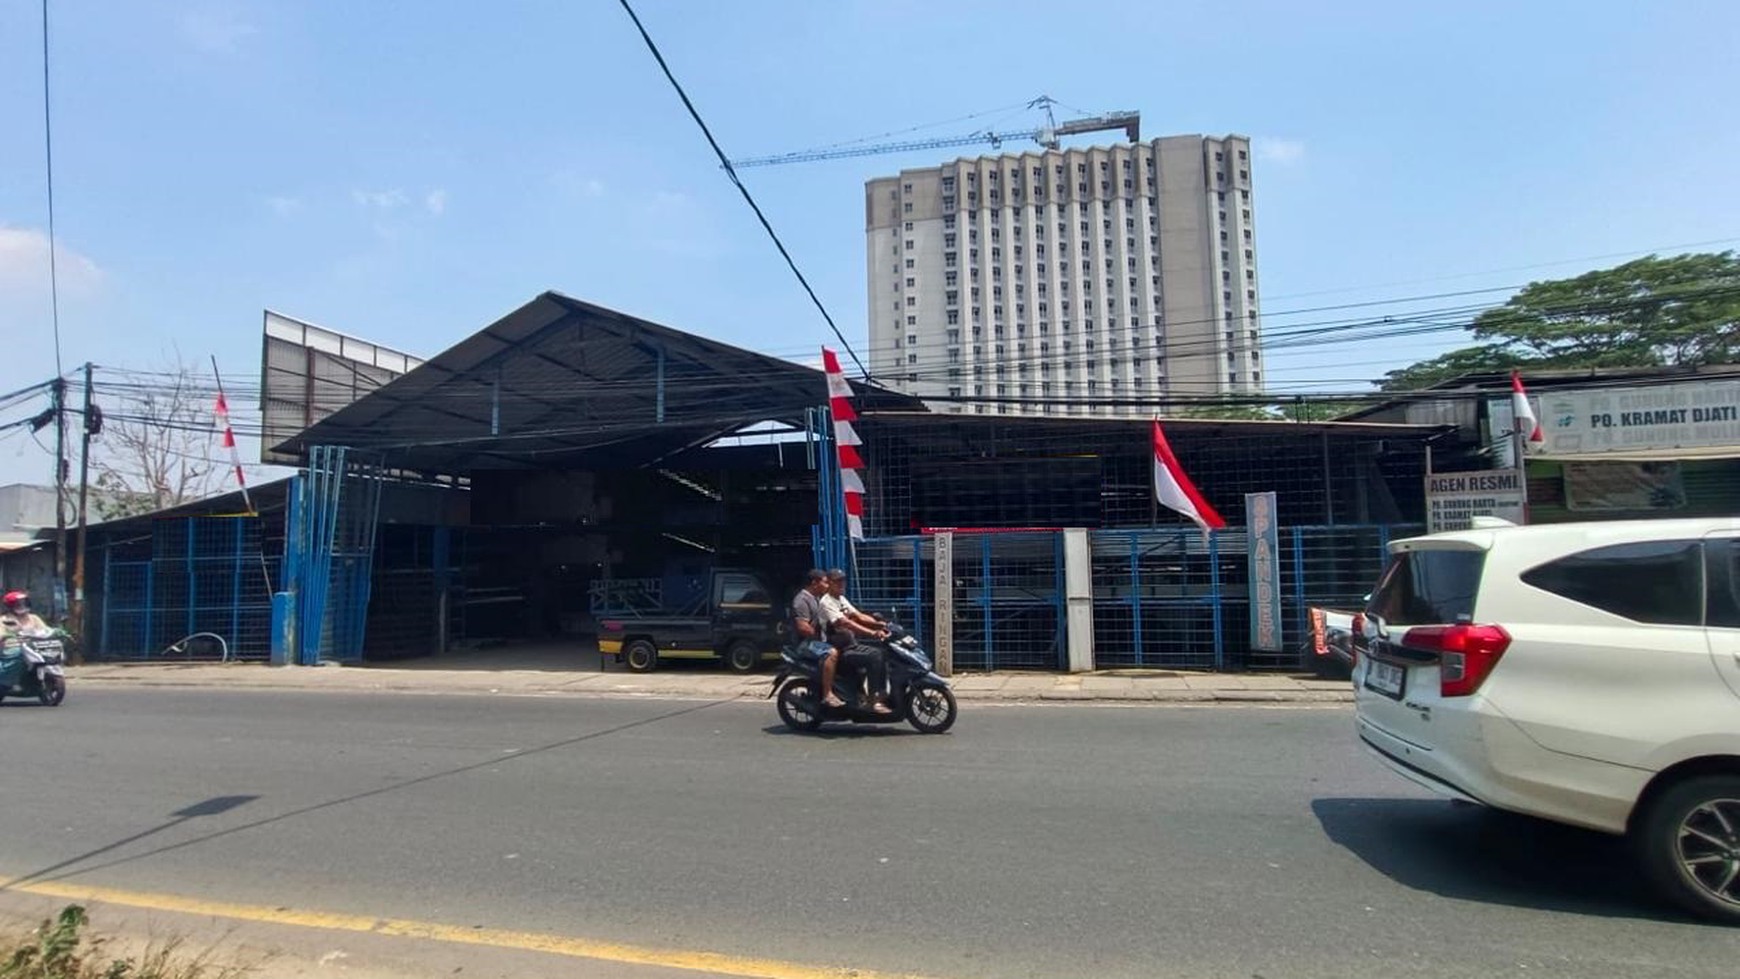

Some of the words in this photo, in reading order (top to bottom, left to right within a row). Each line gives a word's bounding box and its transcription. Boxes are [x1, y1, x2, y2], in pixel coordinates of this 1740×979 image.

[1621, 408, 1688, 427] KRAMAT
[1692, 405, 1738, 423] DJATI
[1431, 477, 1466, 493] AGEN
[1469, 474, 1518, 491] RESMI
